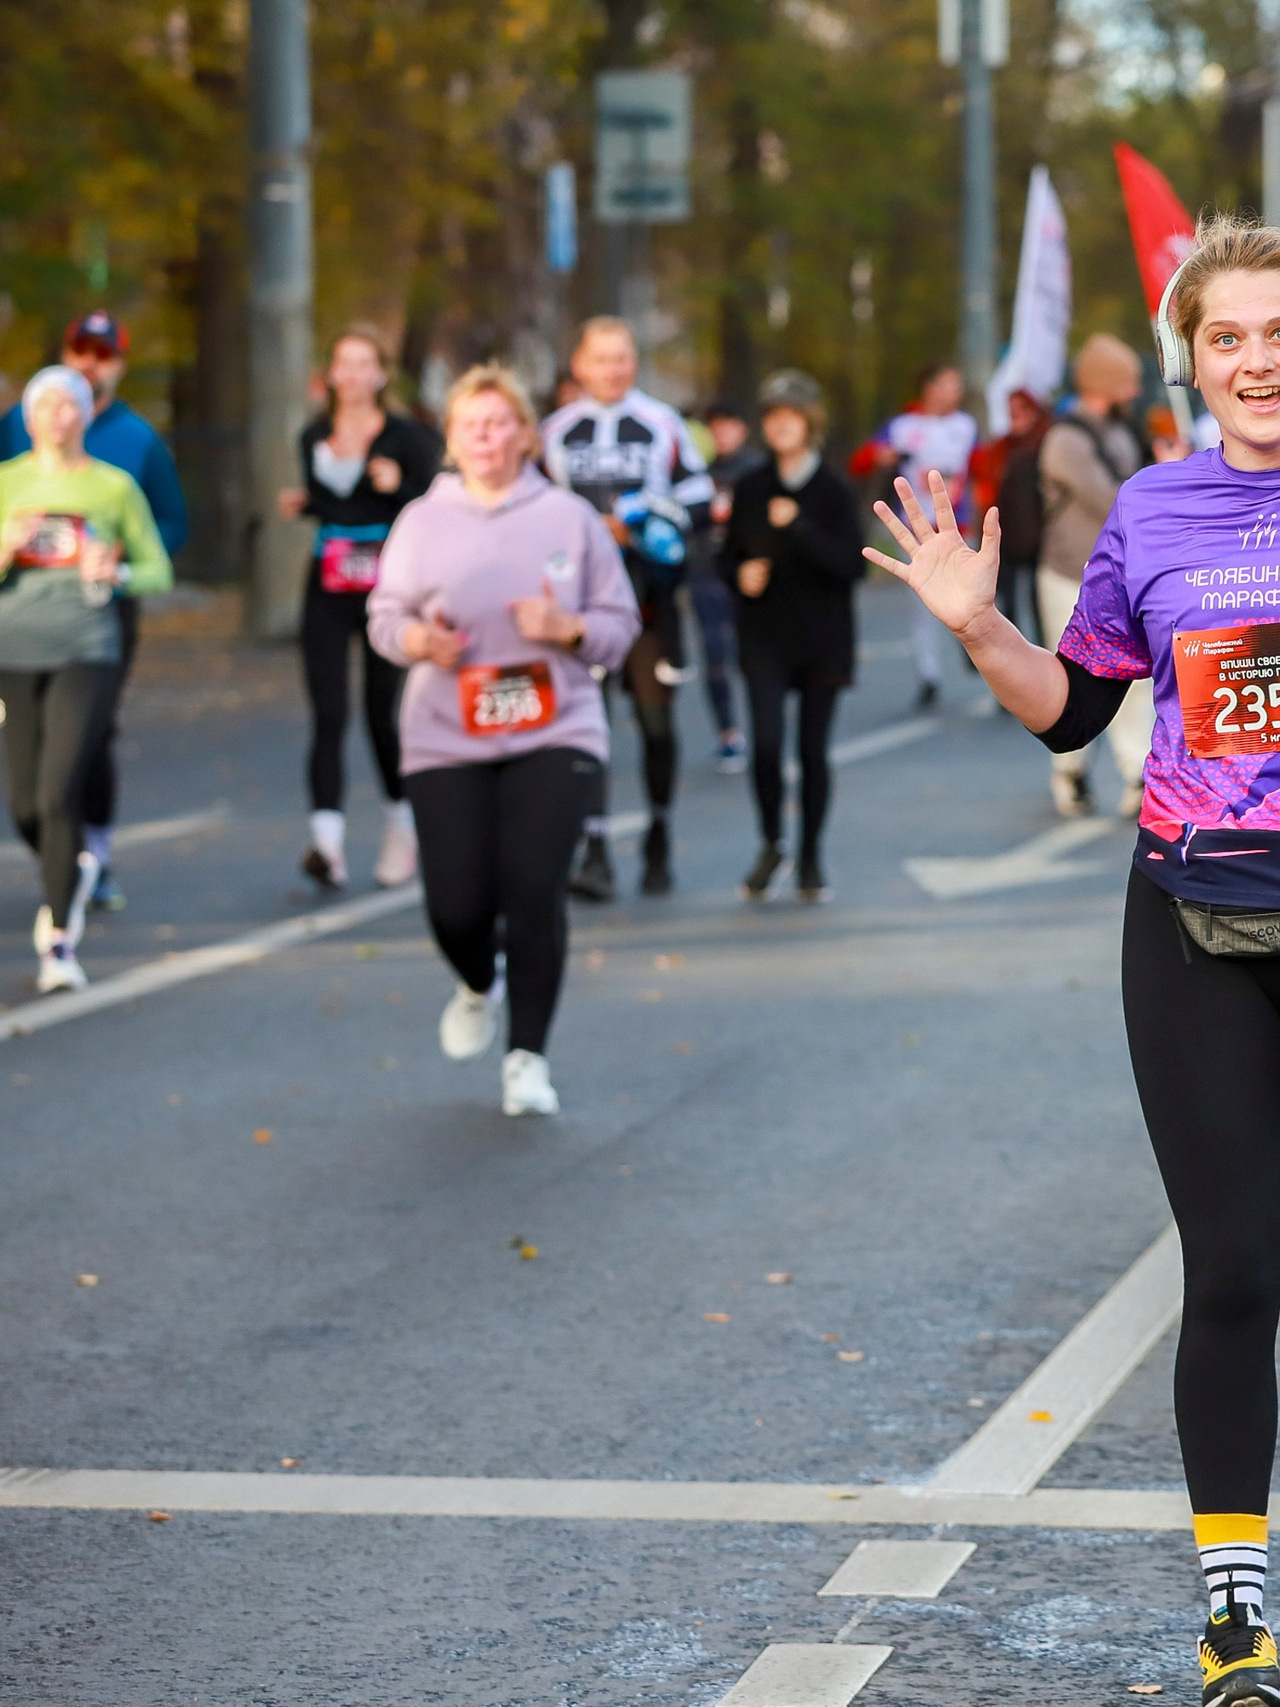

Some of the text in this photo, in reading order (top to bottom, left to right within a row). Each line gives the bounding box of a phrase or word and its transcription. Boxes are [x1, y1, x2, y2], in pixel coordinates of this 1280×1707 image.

[1202, 638, 1243, 648] Челябинский
[1203, 647, 1235, 655] Марафон
[1220, 658, 1255, 670] ВПИШИ
[1219, 672, 1226, 681] В
[1228, 668, 1274, 681] ИСТОРИЮ
[1260, 733, 1268, 743] 5
